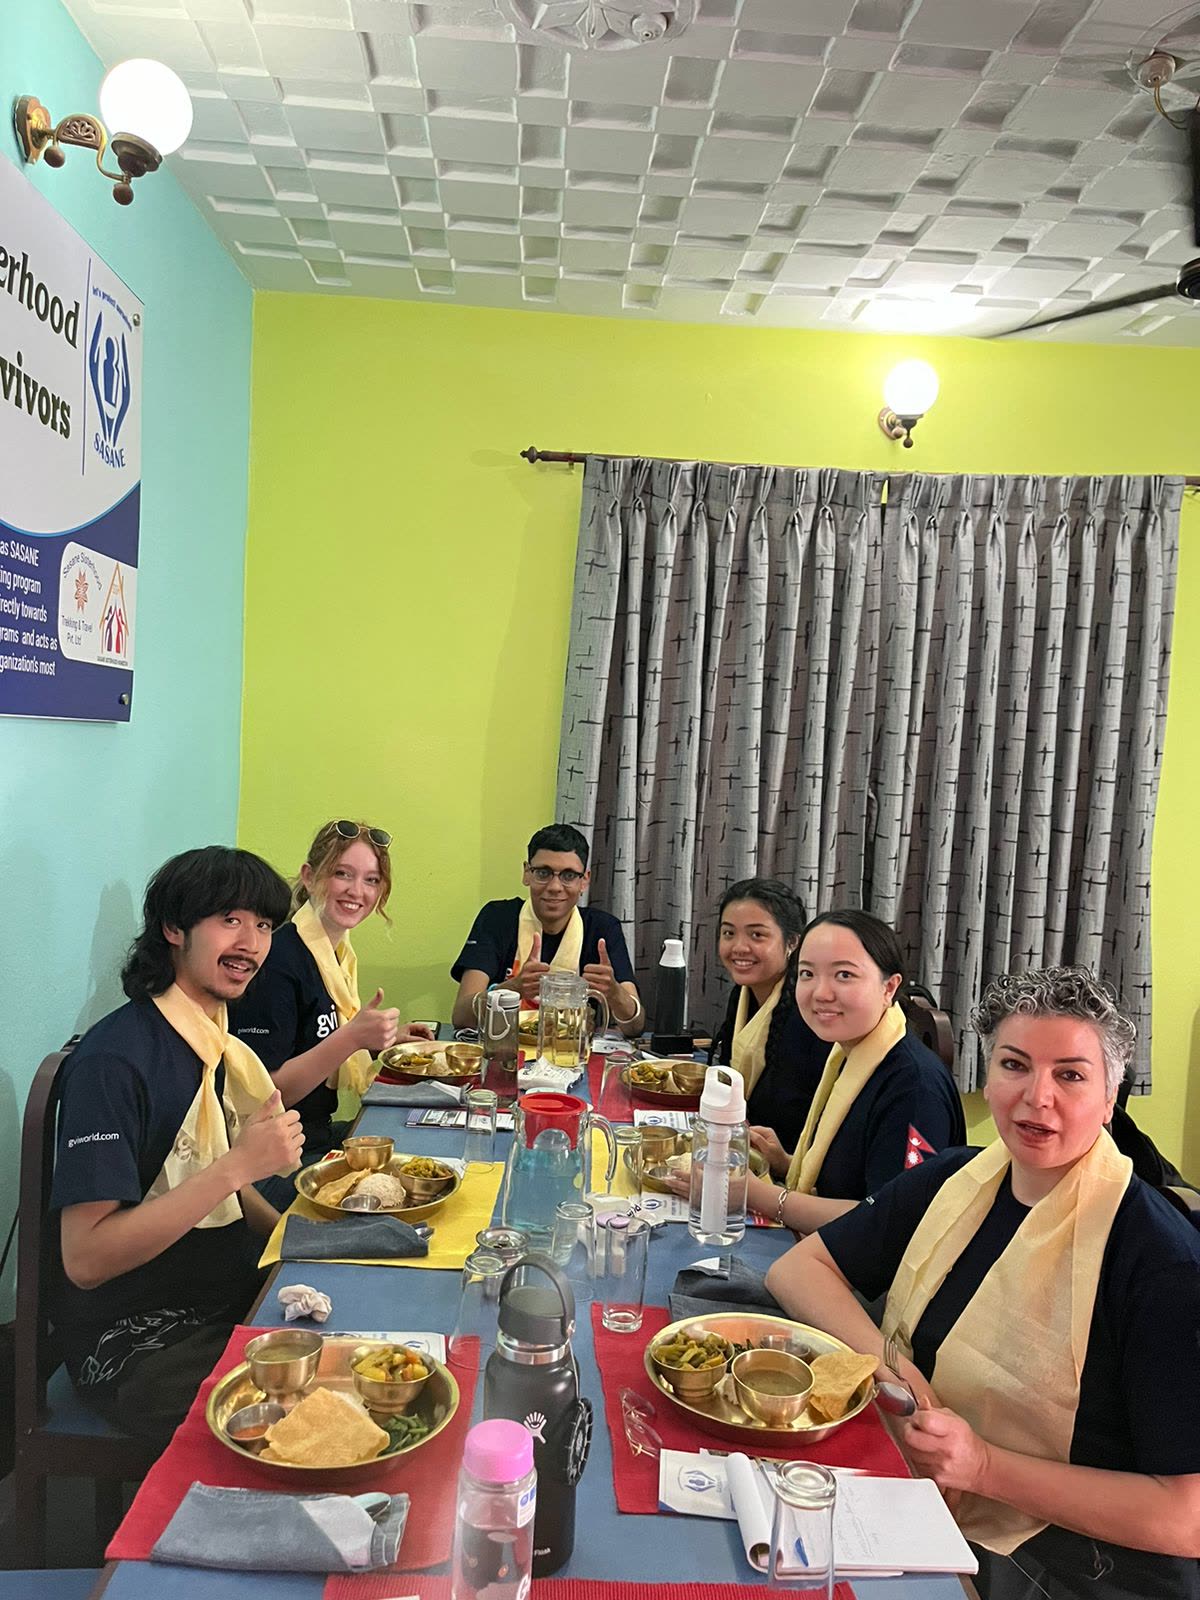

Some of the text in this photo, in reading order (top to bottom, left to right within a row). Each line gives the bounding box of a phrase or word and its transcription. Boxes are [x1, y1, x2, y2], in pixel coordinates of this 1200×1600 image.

[0, 351, 71, 439] vivors
[94, 432, 126, 468] SASANE
[10, 540, 39, 567] SASANE
[12, 574, 41, 594] program
[21, 601, 48, 622] towards
[22, 629, 35, 647] and
[35, 633, 49, 649] acts
[49, 637, 58, 651] as
[39, 660, 56, 676] most
[316, 1004, 339, 1038] gvi
[67, 1132, 120, 1148] gviworld.com
